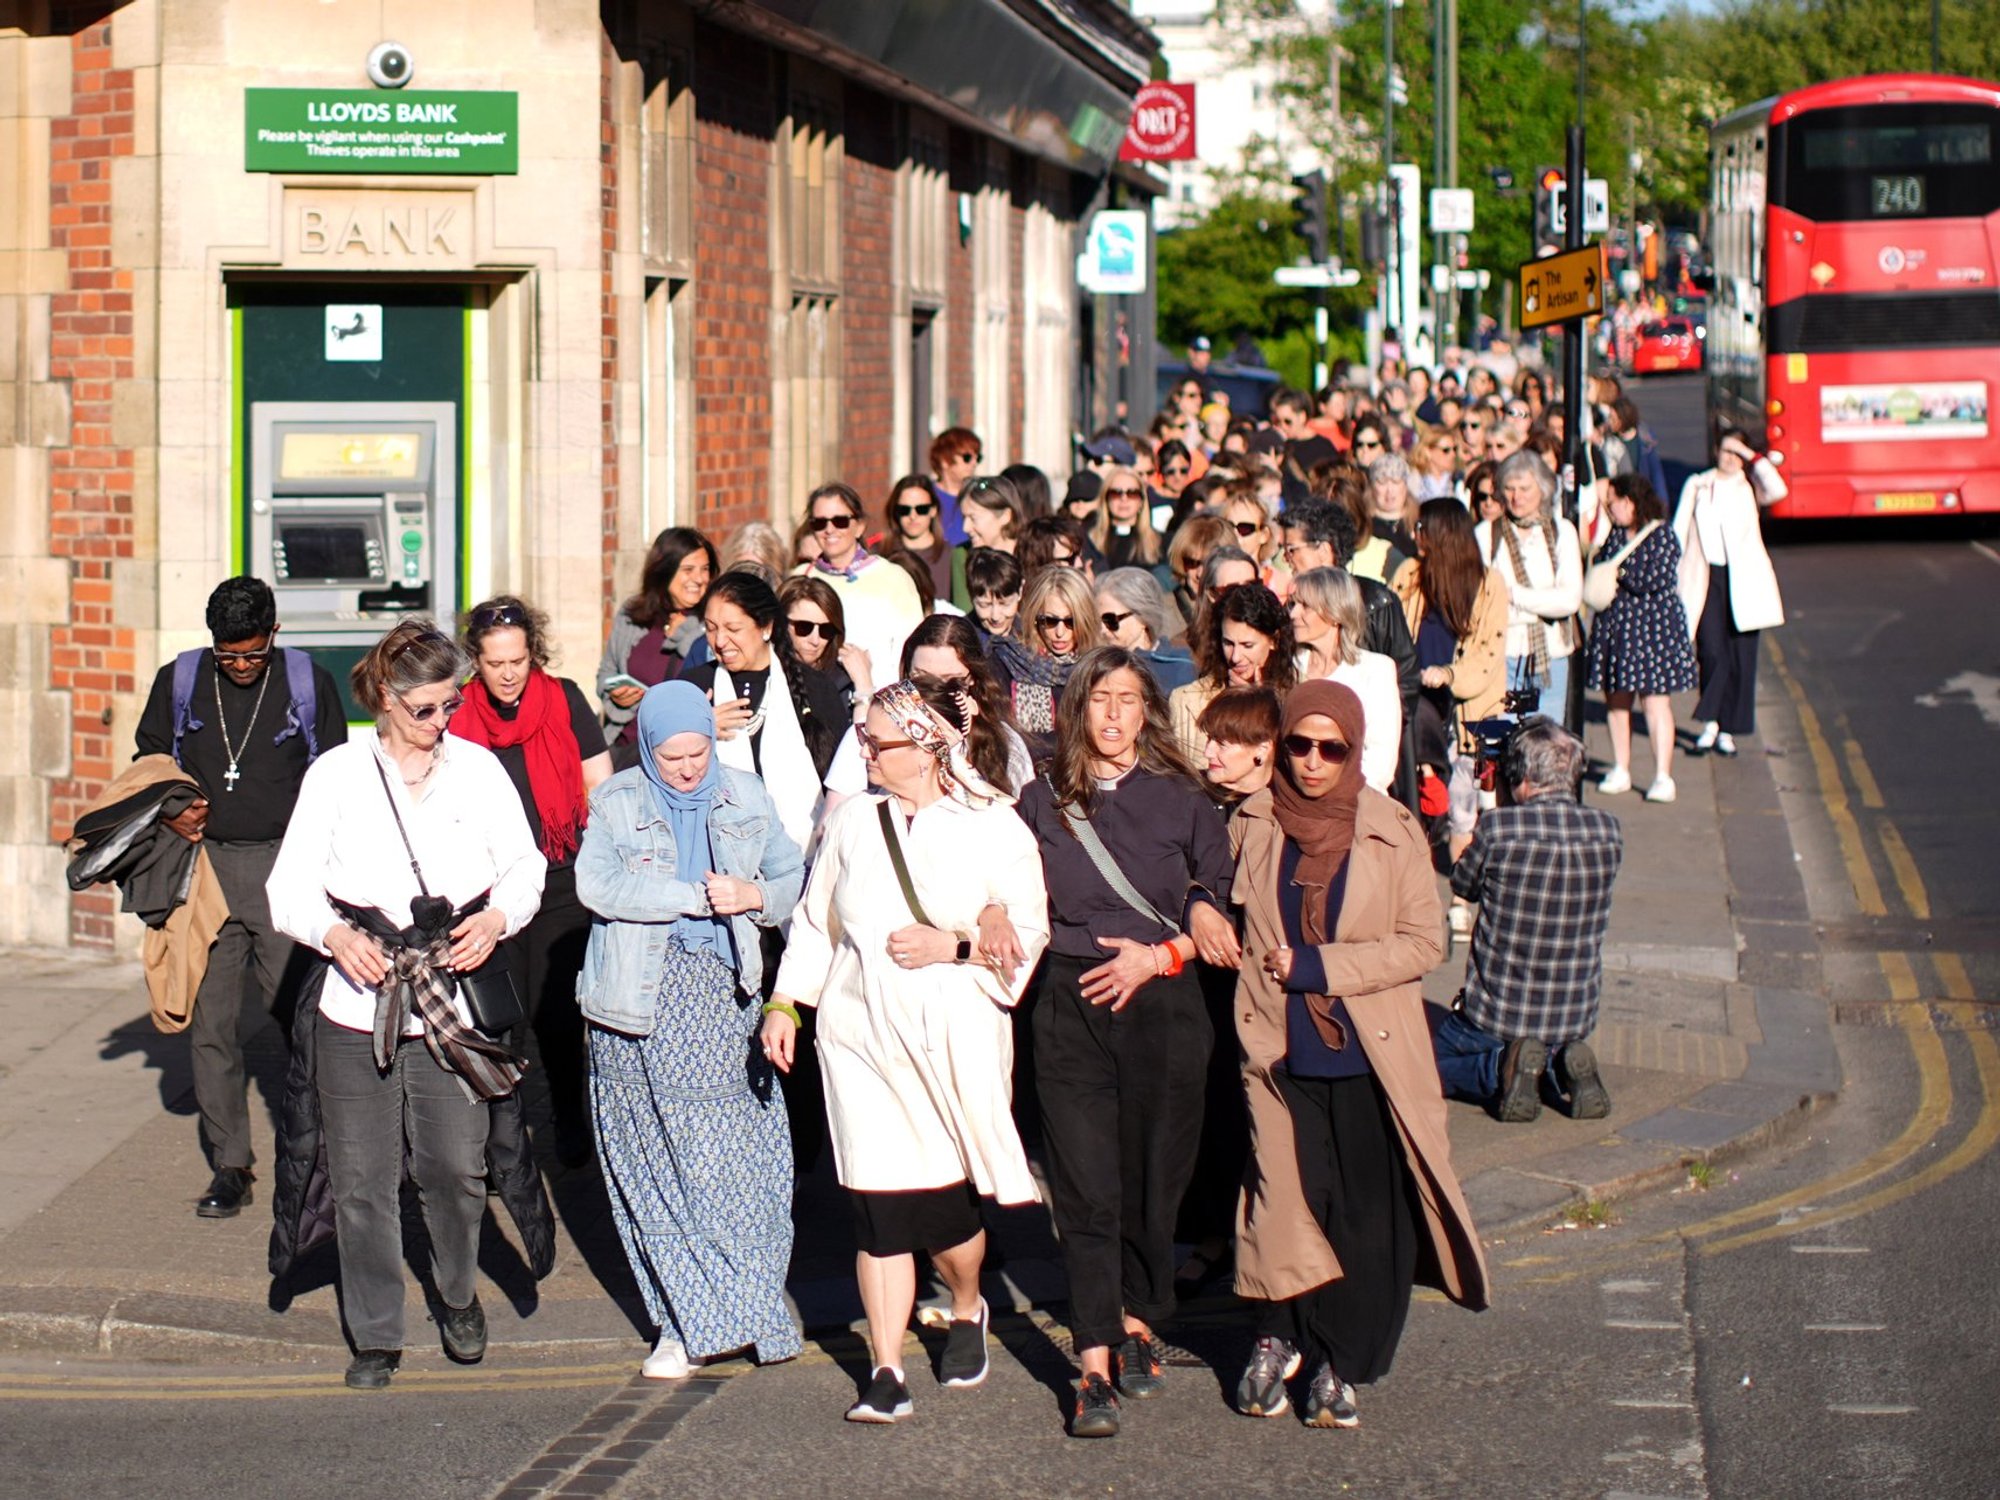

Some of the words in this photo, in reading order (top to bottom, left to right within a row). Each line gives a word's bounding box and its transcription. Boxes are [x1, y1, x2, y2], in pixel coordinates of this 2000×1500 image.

[308, 102, 391, 122] LLOYDS
[396, 103, 458, 123] BANK
[258, 129, 296, 142] Please
[297, 130, 313, 142] be
[315, 130, 357, 145] vigilant
[358, 130, 391, 143] when
[392, 131, 423, 146] using
[424, 133, 443, 144] our
[306, 143, 350, 156] Thieves
[351, 145, 397, 158] operate
[398, 145, 410, 157] in
[411, 145, 432, 157] this
[434, 147, 460, 158] area
[1876, 176, 1921, 213] 240
[299, 205, 456, 255] BANK
[1545, 270, 1562, 287] The
[1547, 291, 1579, 309] Artisan
